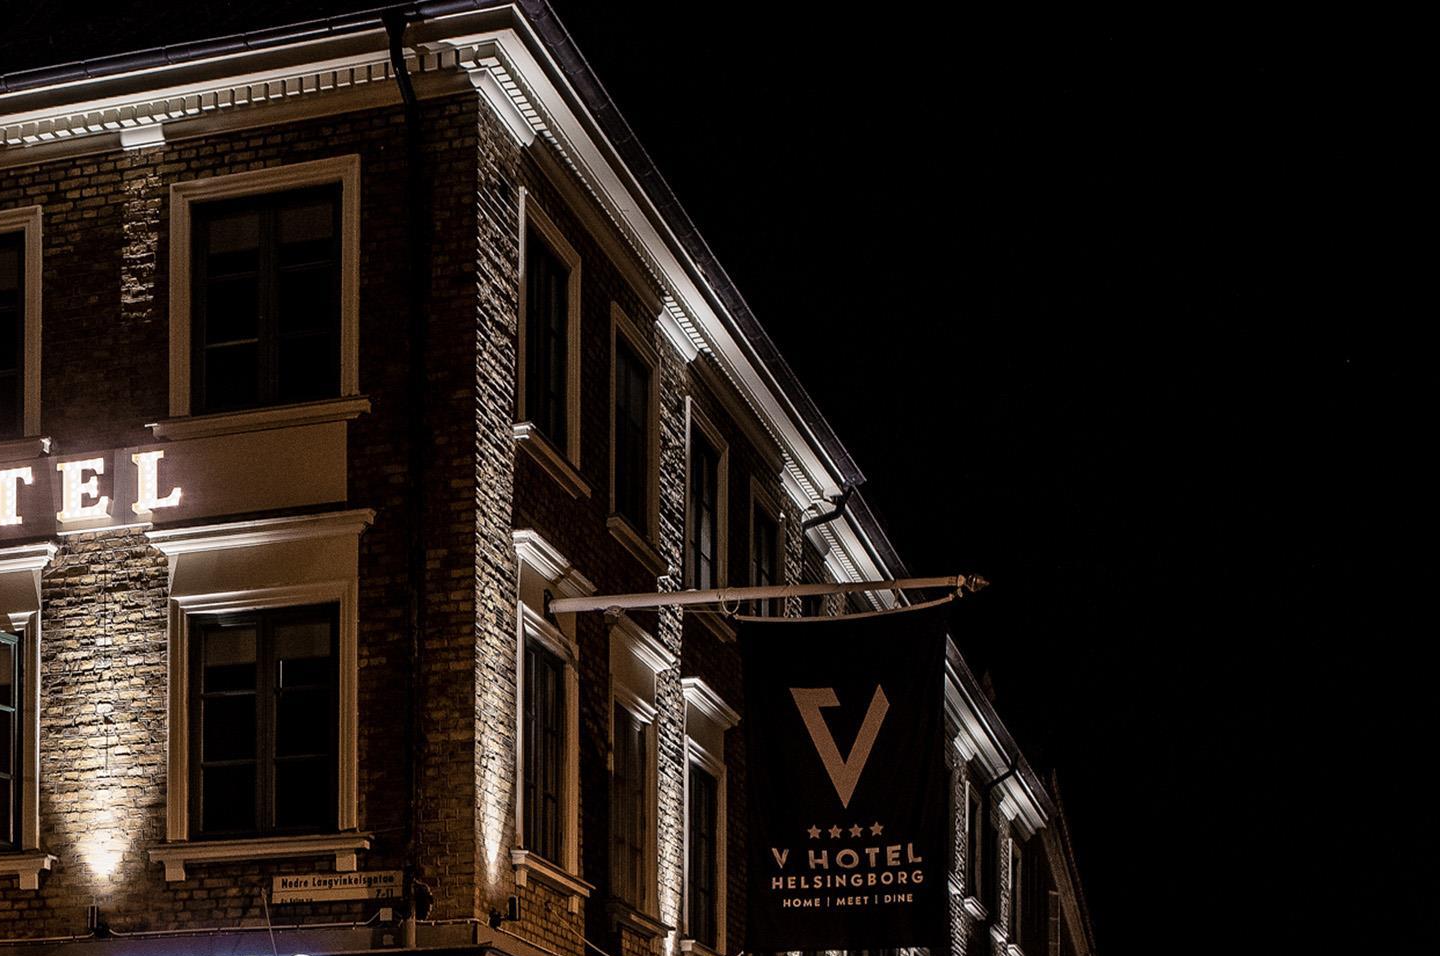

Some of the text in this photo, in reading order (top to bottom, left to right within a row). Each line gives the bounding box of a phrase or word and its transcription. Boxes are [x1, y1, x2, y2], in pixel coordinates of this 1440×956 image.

[789, 684, 890, 809] V
[771, 843, 923, 870] V HOTEL
[281, 878, 308, 889] Nedre
[771, 870, 924, 890] HELSINGBORG
[783, 893, 913, 908] HOME MEET DINE
